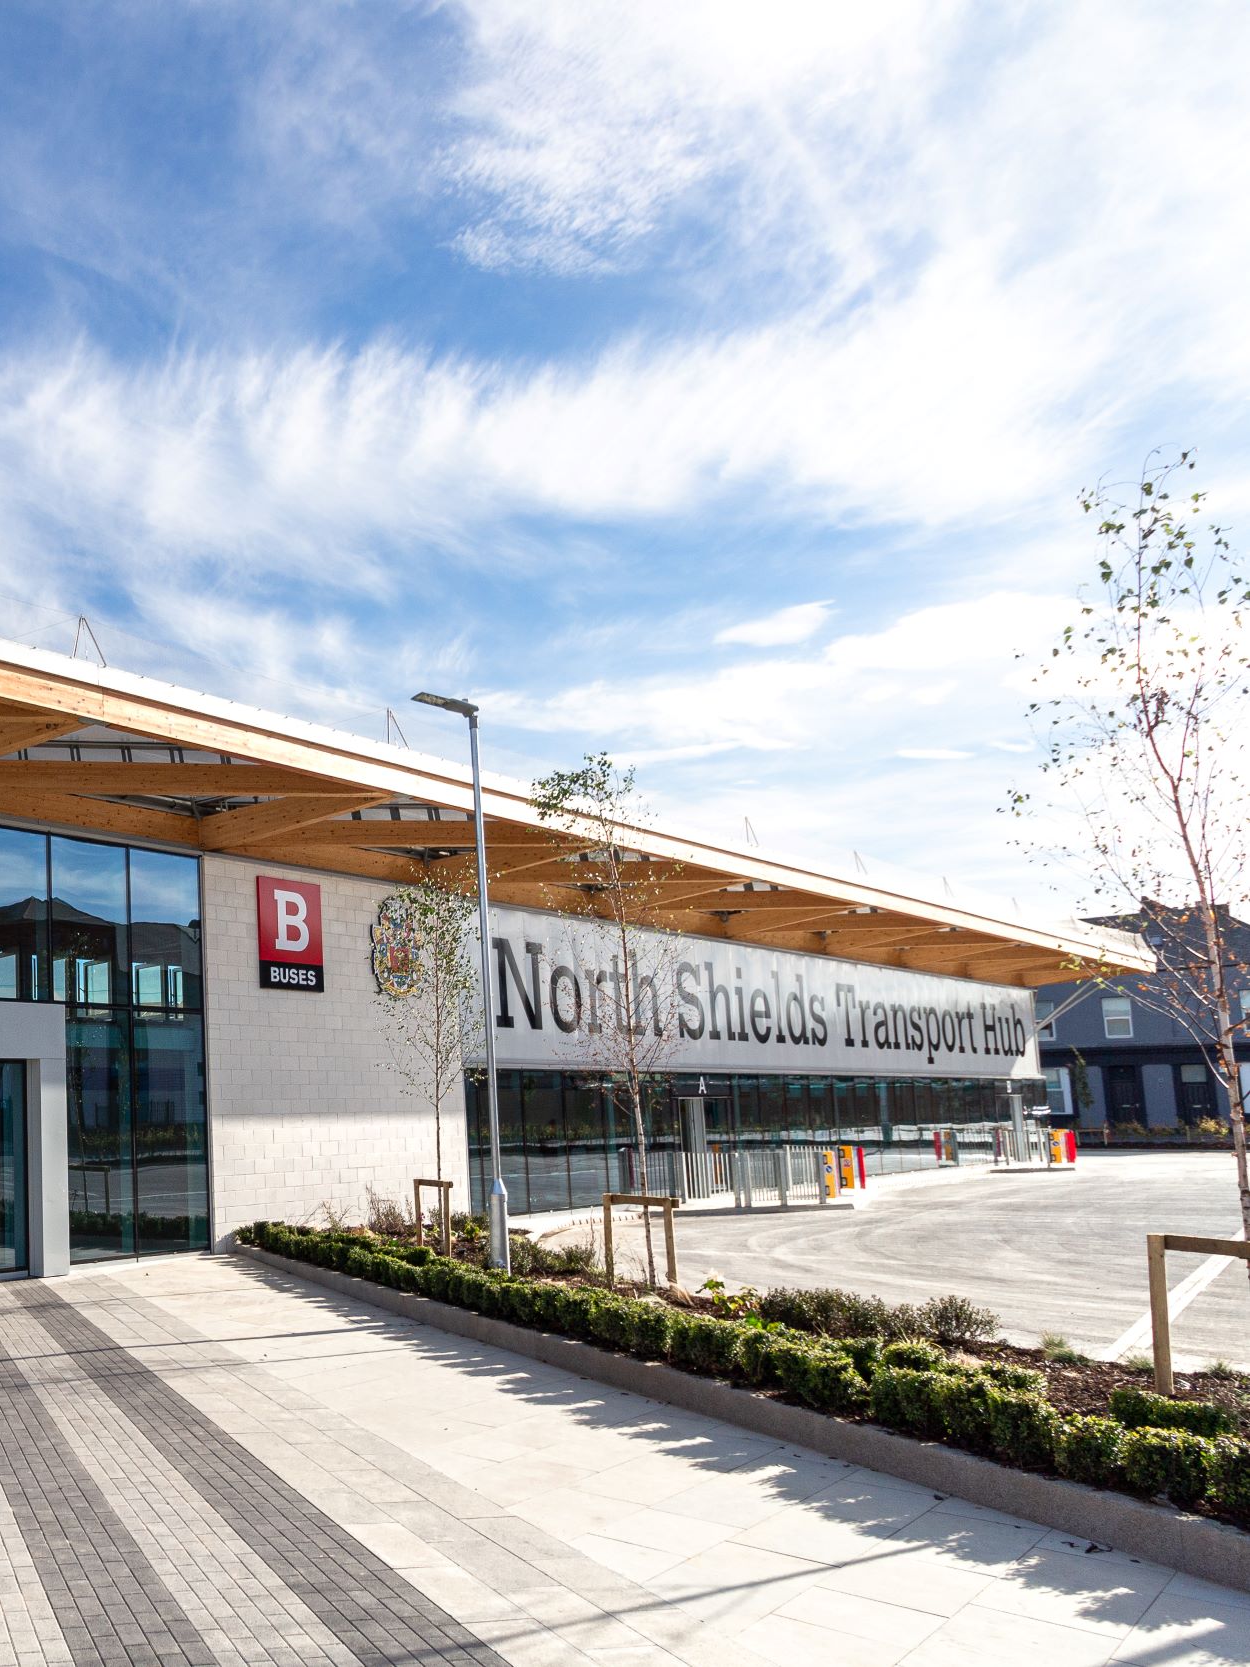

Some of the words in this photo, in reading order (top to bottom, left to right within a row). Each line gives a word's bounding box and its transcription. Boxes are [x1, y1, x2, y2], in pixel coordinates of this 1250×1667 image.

[273, 888, 310, 952] B
[270, 966, 316, 986] BUSES
[491, 936, 664, 1038] North
[676, 961, 828, 1047] Shields
[836, 983, 978, 1065] Transport
[979, 1002, 1026, 1057] Hub
[698, 1075, 708, 1095] A
